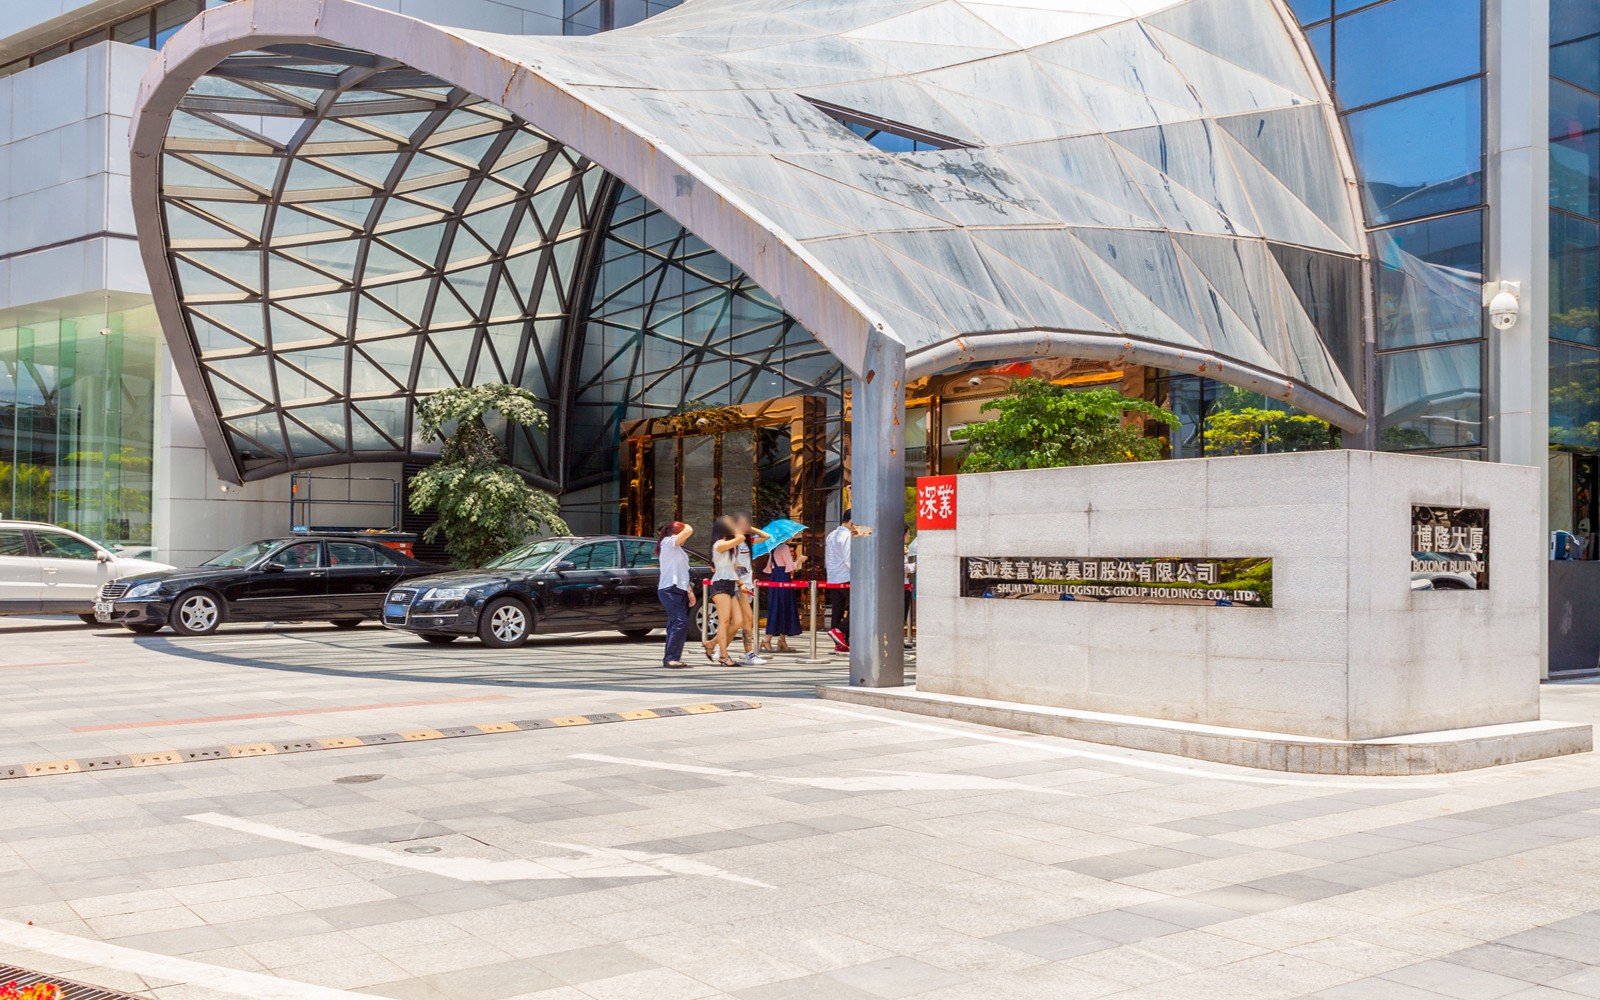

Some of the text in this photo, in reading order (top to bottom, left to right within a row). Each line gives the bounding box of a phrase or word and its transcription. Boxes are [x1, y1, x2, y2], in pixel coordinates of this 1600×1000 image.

[1417, 525, 1484, 554] 博隆大厦
[969, 560, 1215, 585] 深业泰富物流集团股份有限公司
[1412, 560, 1485, 574] BOLONG BUILDING
[997, 583, 1022, 594] SHUM
[1024, 583, 1037, 594] YIP
[1039, 583, 1063, 595] TAIFU
[1065, 584, 1111, 597] LOGISTICS
[1113, 586, 1147, 598] GROUP
[1150, 587, 1204, 600] HOLDINGS
